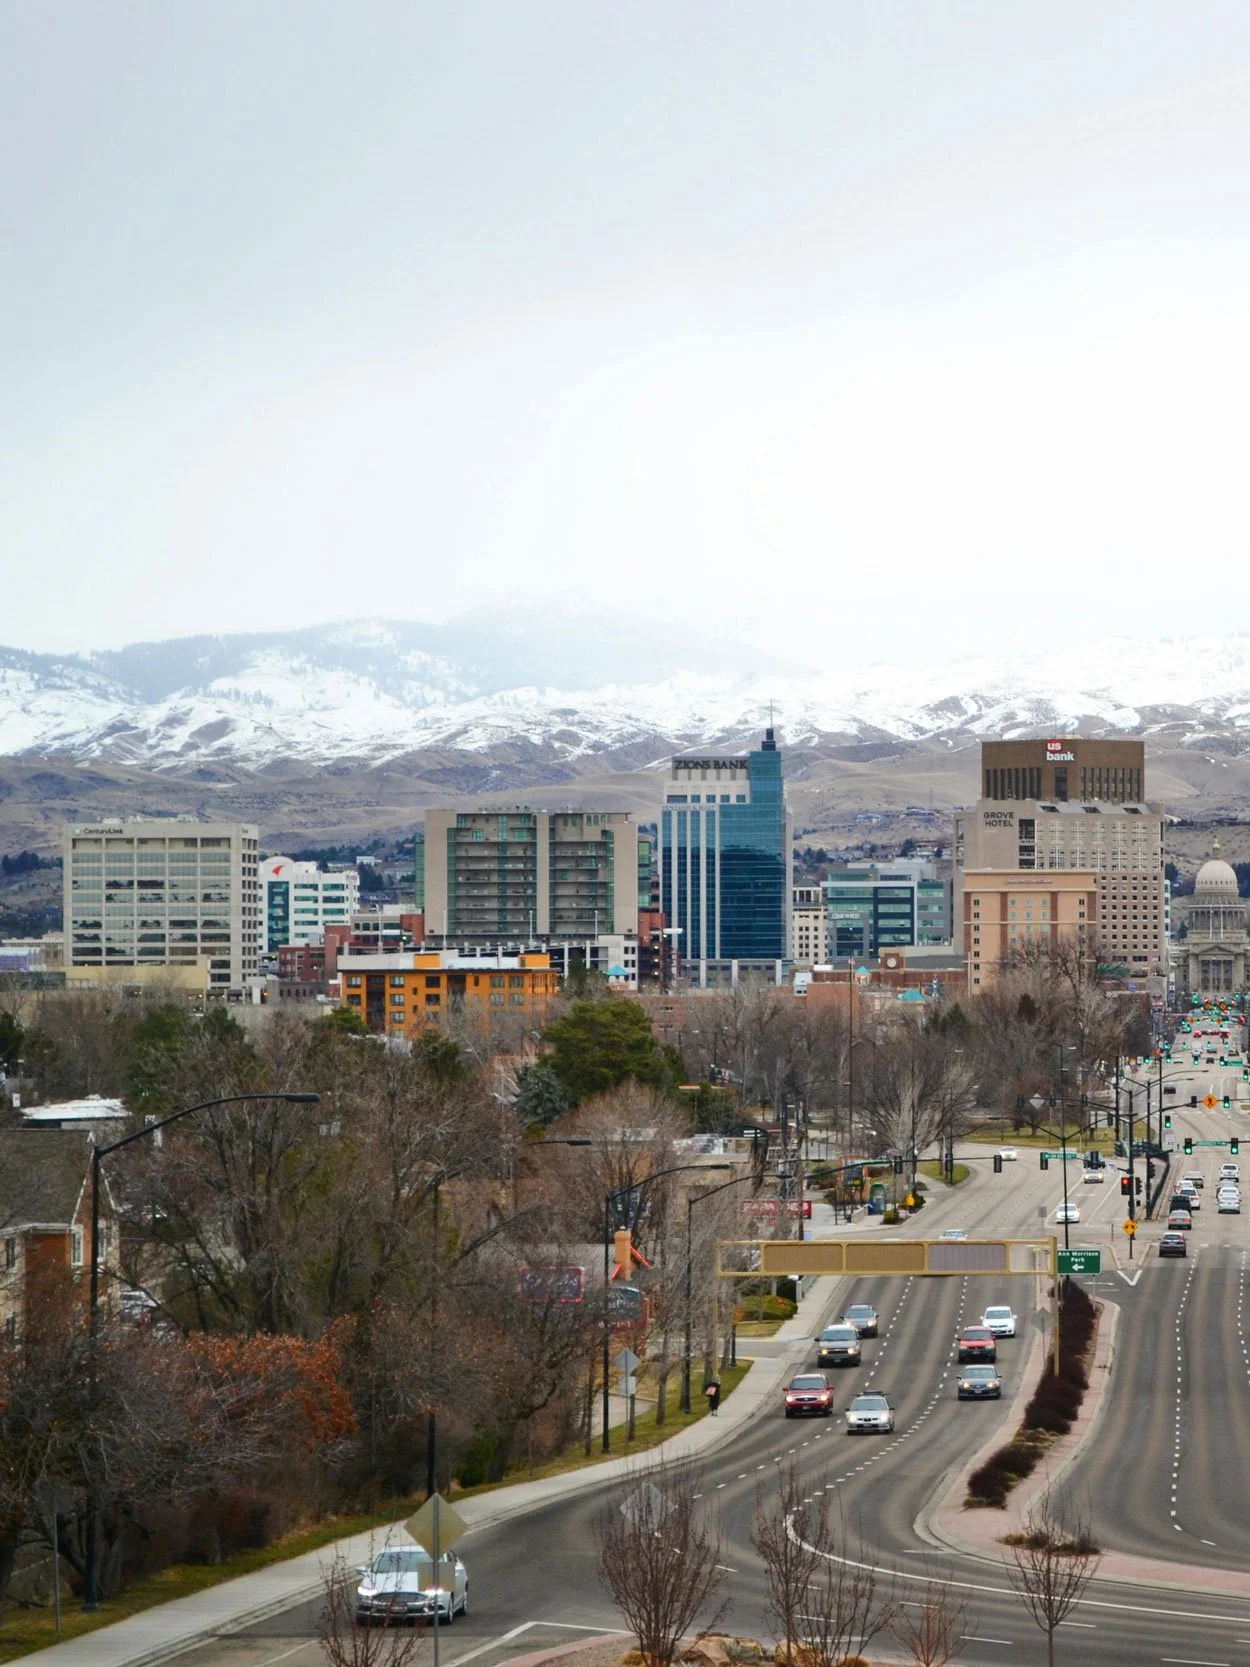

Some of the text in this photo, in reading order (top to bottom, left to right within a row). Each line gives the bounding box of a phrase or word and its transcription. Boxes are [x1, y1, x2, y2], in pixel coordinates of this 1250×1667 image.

[1046, 742, 1062, 750] us
[1046, 751, 1075, 761] bank
[675, 760, 749, 769] ZIONS BANK
[983, 811, 1014, 819] GROVE
[985, 819, 1014, 827] HOTEL
